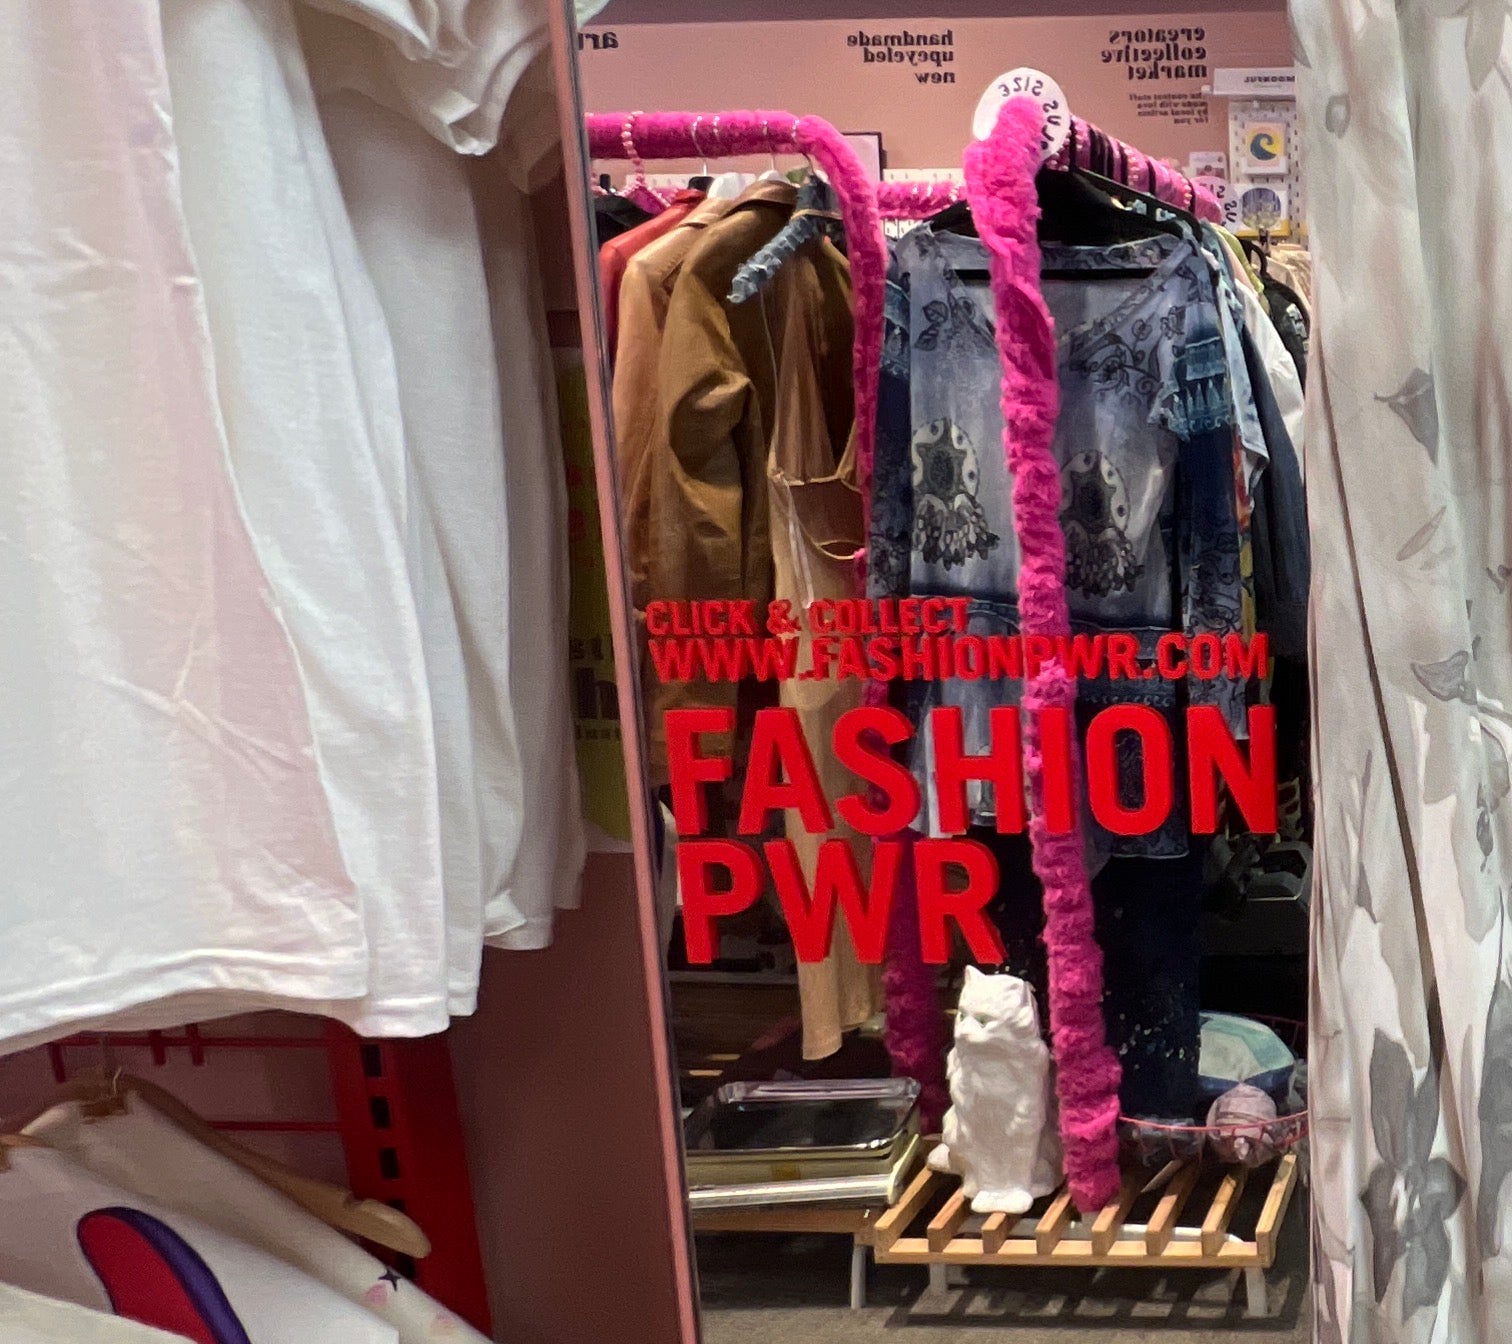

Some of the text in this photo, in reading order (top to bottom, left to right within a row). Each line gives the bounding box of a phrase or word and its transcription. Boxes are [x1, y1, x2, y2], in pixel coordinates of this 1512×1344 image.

[645, 596, 974, 636] CLICK & COLLECT
[649, 634, 1269, 681] WWW.FASHIONPWR.COM
[664, 705, 1279, 837] FASHION
[676, 840, 1007, 964] PWR
